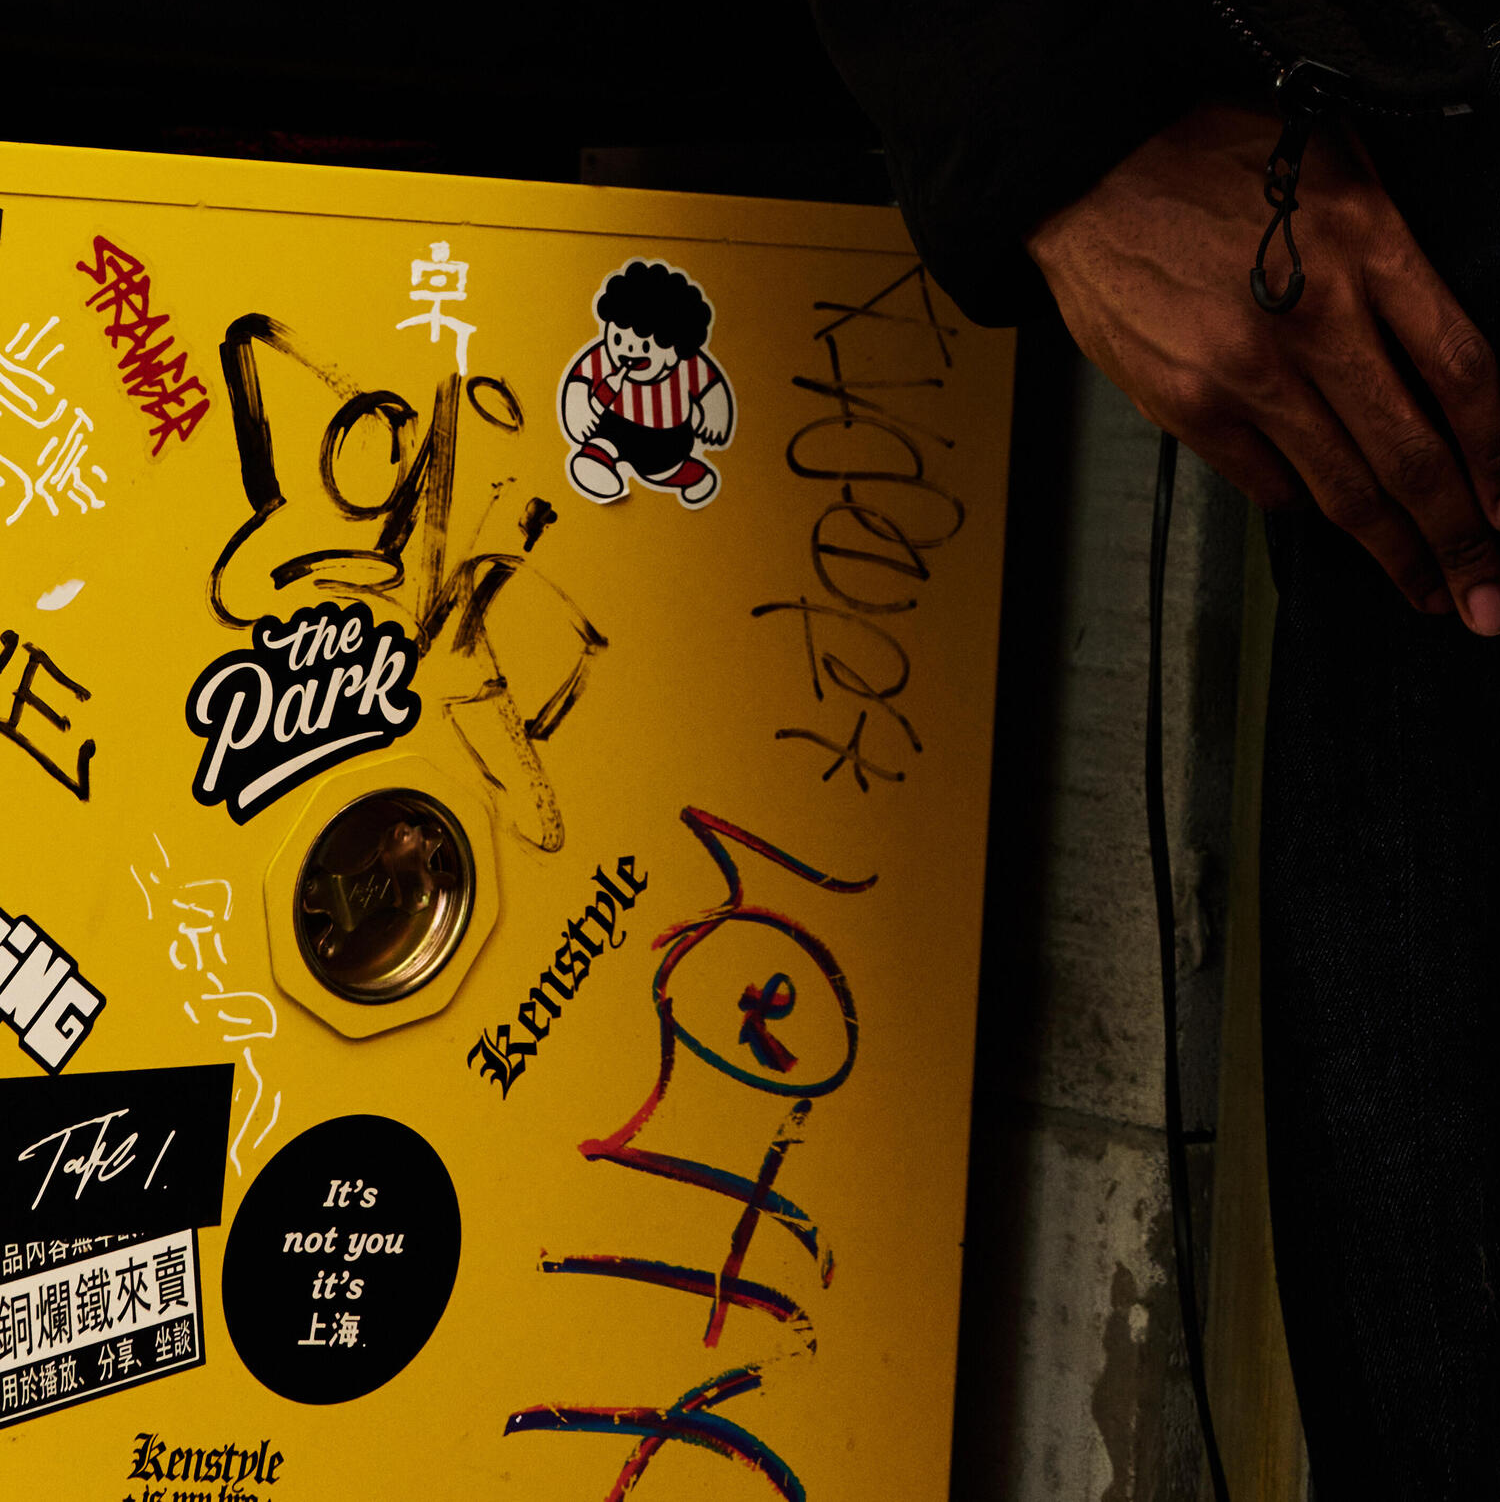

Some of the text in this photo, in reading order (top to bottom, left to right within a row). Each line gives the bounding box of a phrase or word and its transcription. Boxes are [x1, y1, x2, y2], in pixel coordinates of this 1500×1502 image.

[262, 616, 363, 671] the
[195, 635, 409, 792] Park
[467, 855, 648, 1101] Kenstyle
[323, 1179, 378, 1208] It's
[282, 1227, 404, 1262] not you
[312, 1270, 365, 1300] it's
[127, 1432, 285, 1493] Kenstyle
